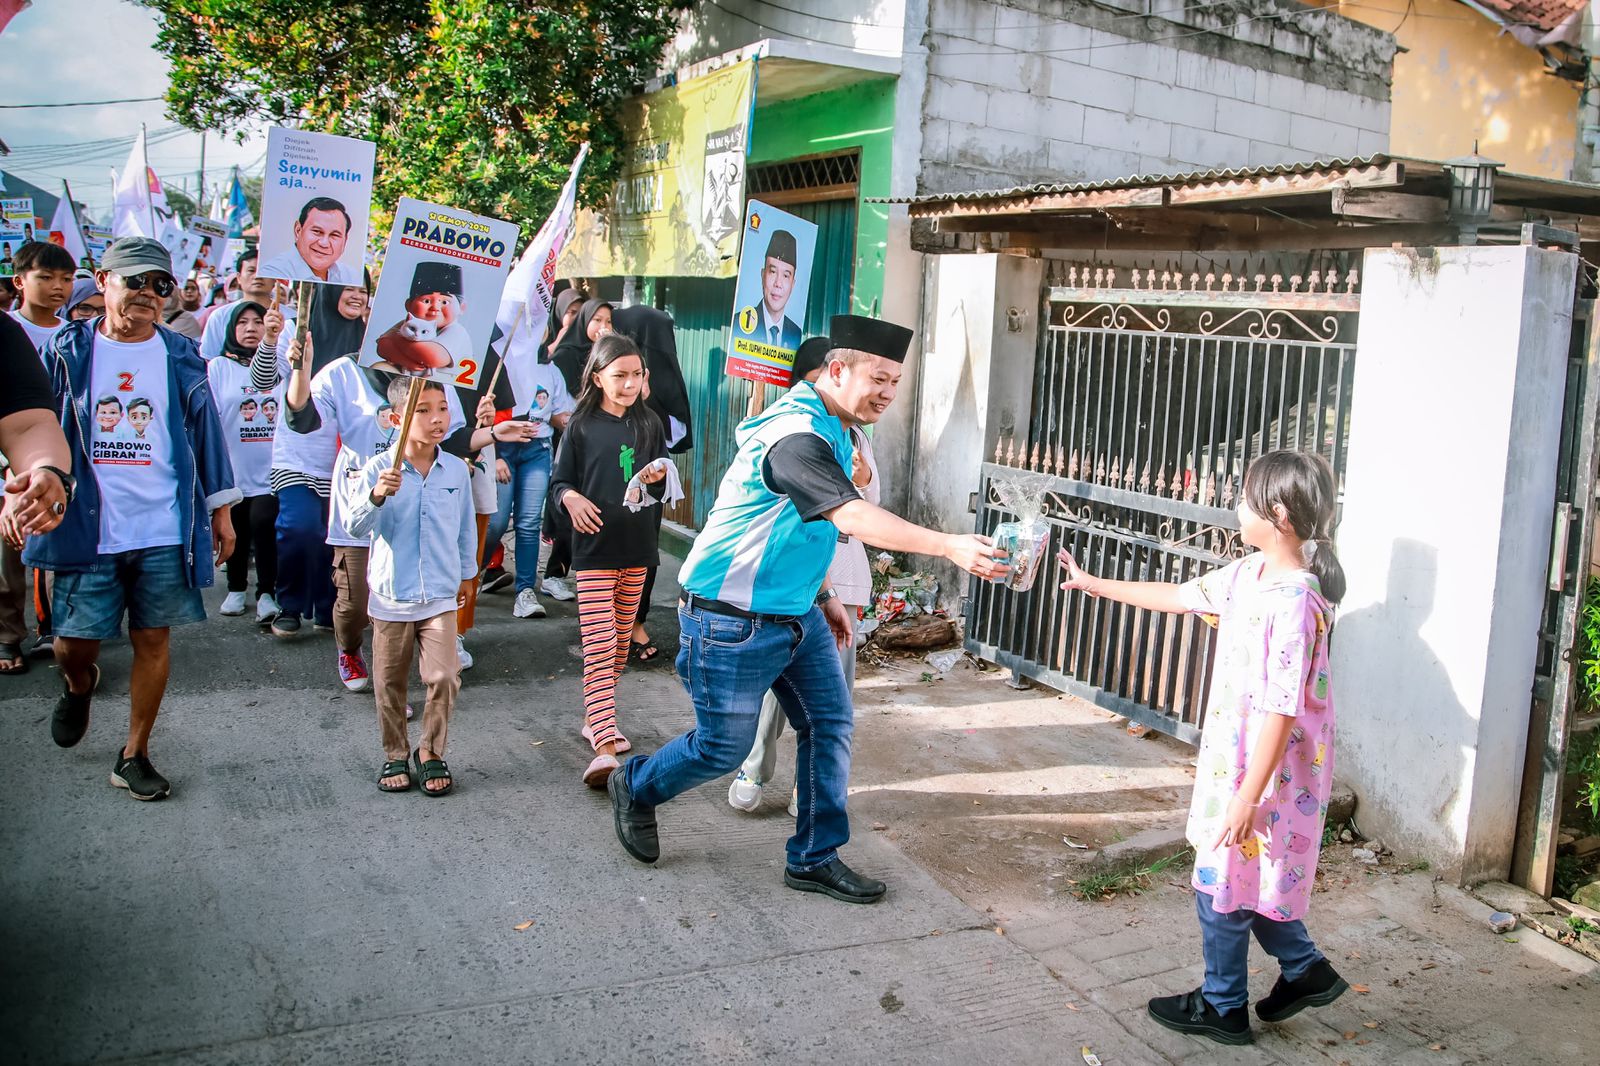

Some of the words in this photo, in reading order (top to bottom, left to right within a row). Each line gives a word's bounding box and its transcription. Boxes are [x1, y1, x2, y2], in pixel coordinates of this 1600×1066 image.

[278, 159, 361, 182] Senyumin
[279, 176, 317, 190] aja...
[437, 213, 468, 229] GEMOY
[469, 222, 491, 234] 2024
[402, 217, 506, 258] PRABOWO
[405, 239, 439, 252] BERSAMA
[439, 247, 478, 261] INDONESIA
[479, 257, 498, 266] MAJU
[746, 310, 752, 328] 1
[777, 350, 794, 363] AHMAD
[117, 371, 135, 392] 2
[455, 358, 477, 385] 2
[93, 441, 152, 451] PRABOWO
[93, 450, 136, 459] GIBRAN
